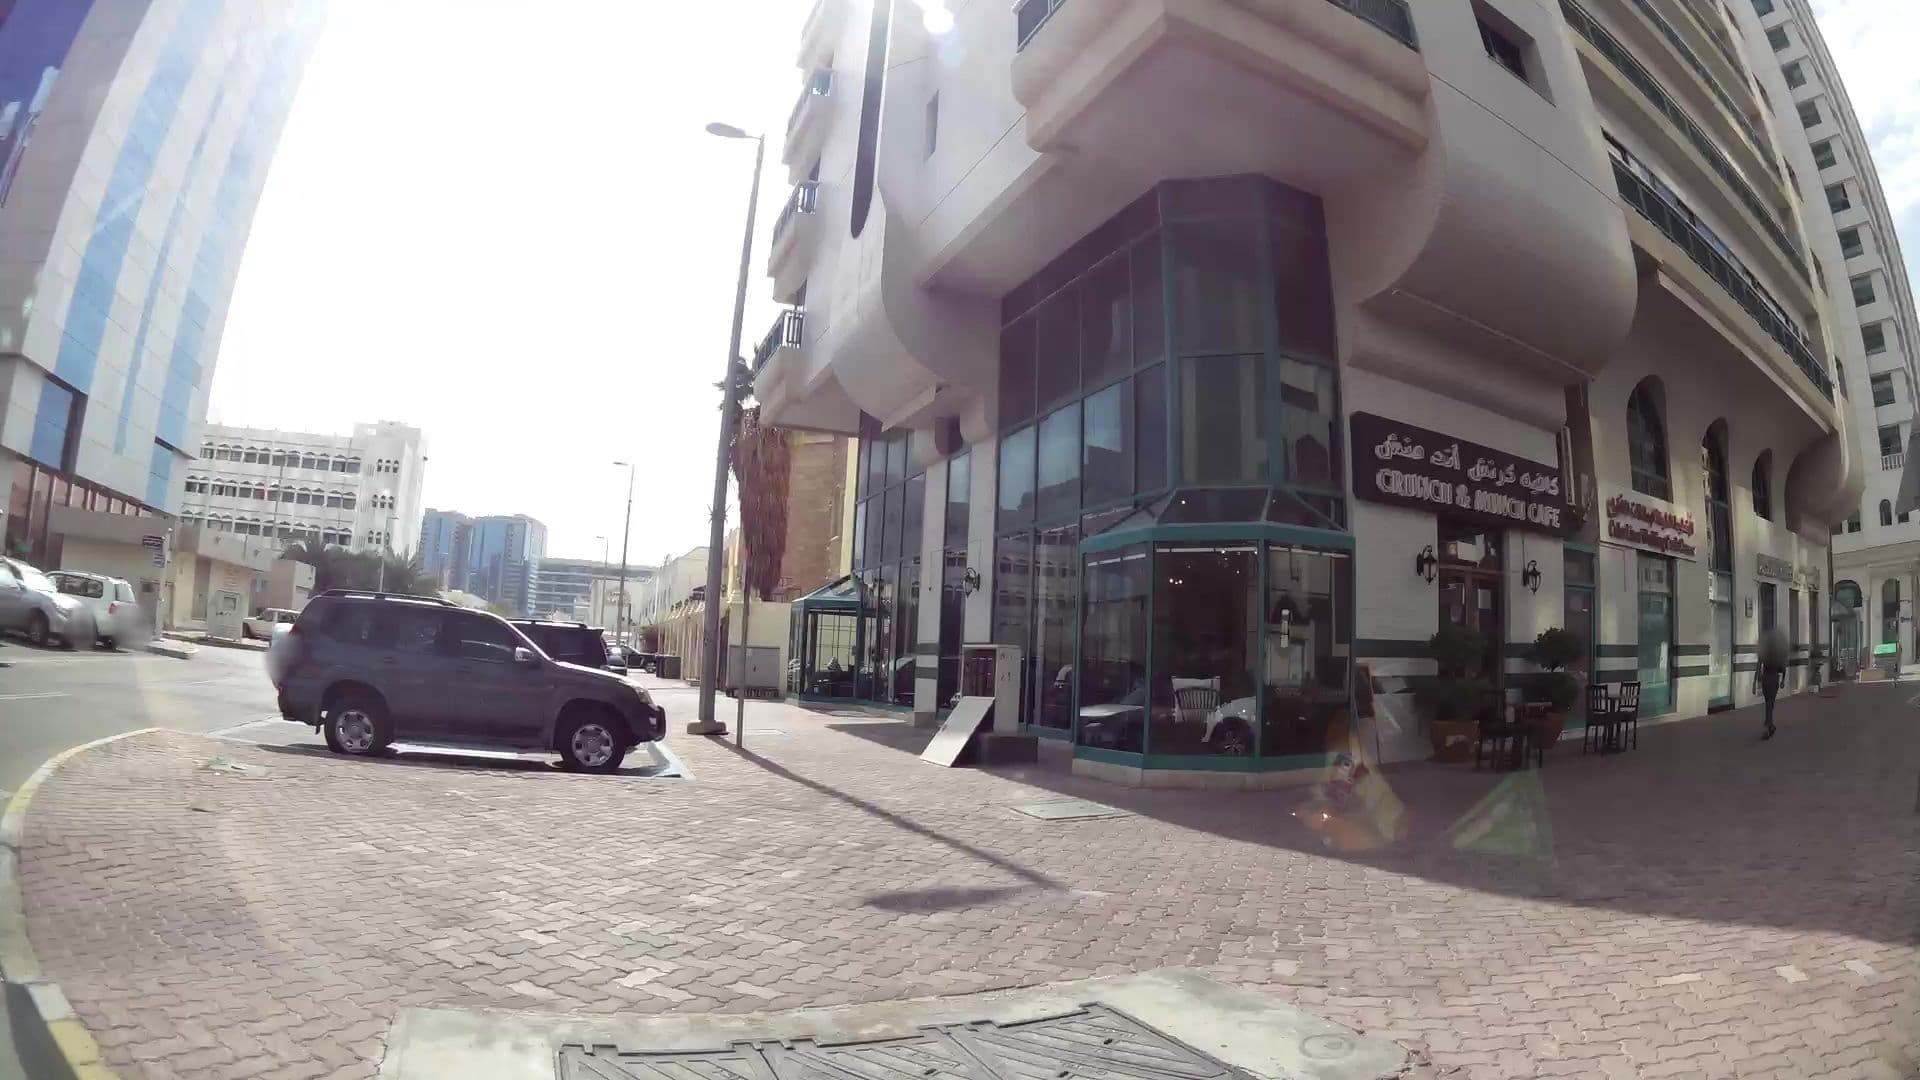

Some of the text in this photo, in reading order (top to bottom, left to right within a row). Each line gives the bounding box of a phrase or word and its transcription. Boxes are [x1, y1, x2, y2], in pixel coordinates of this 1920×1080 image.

[1375, 468, 1561, 528] CRUNCH & MUNCH CAFE
